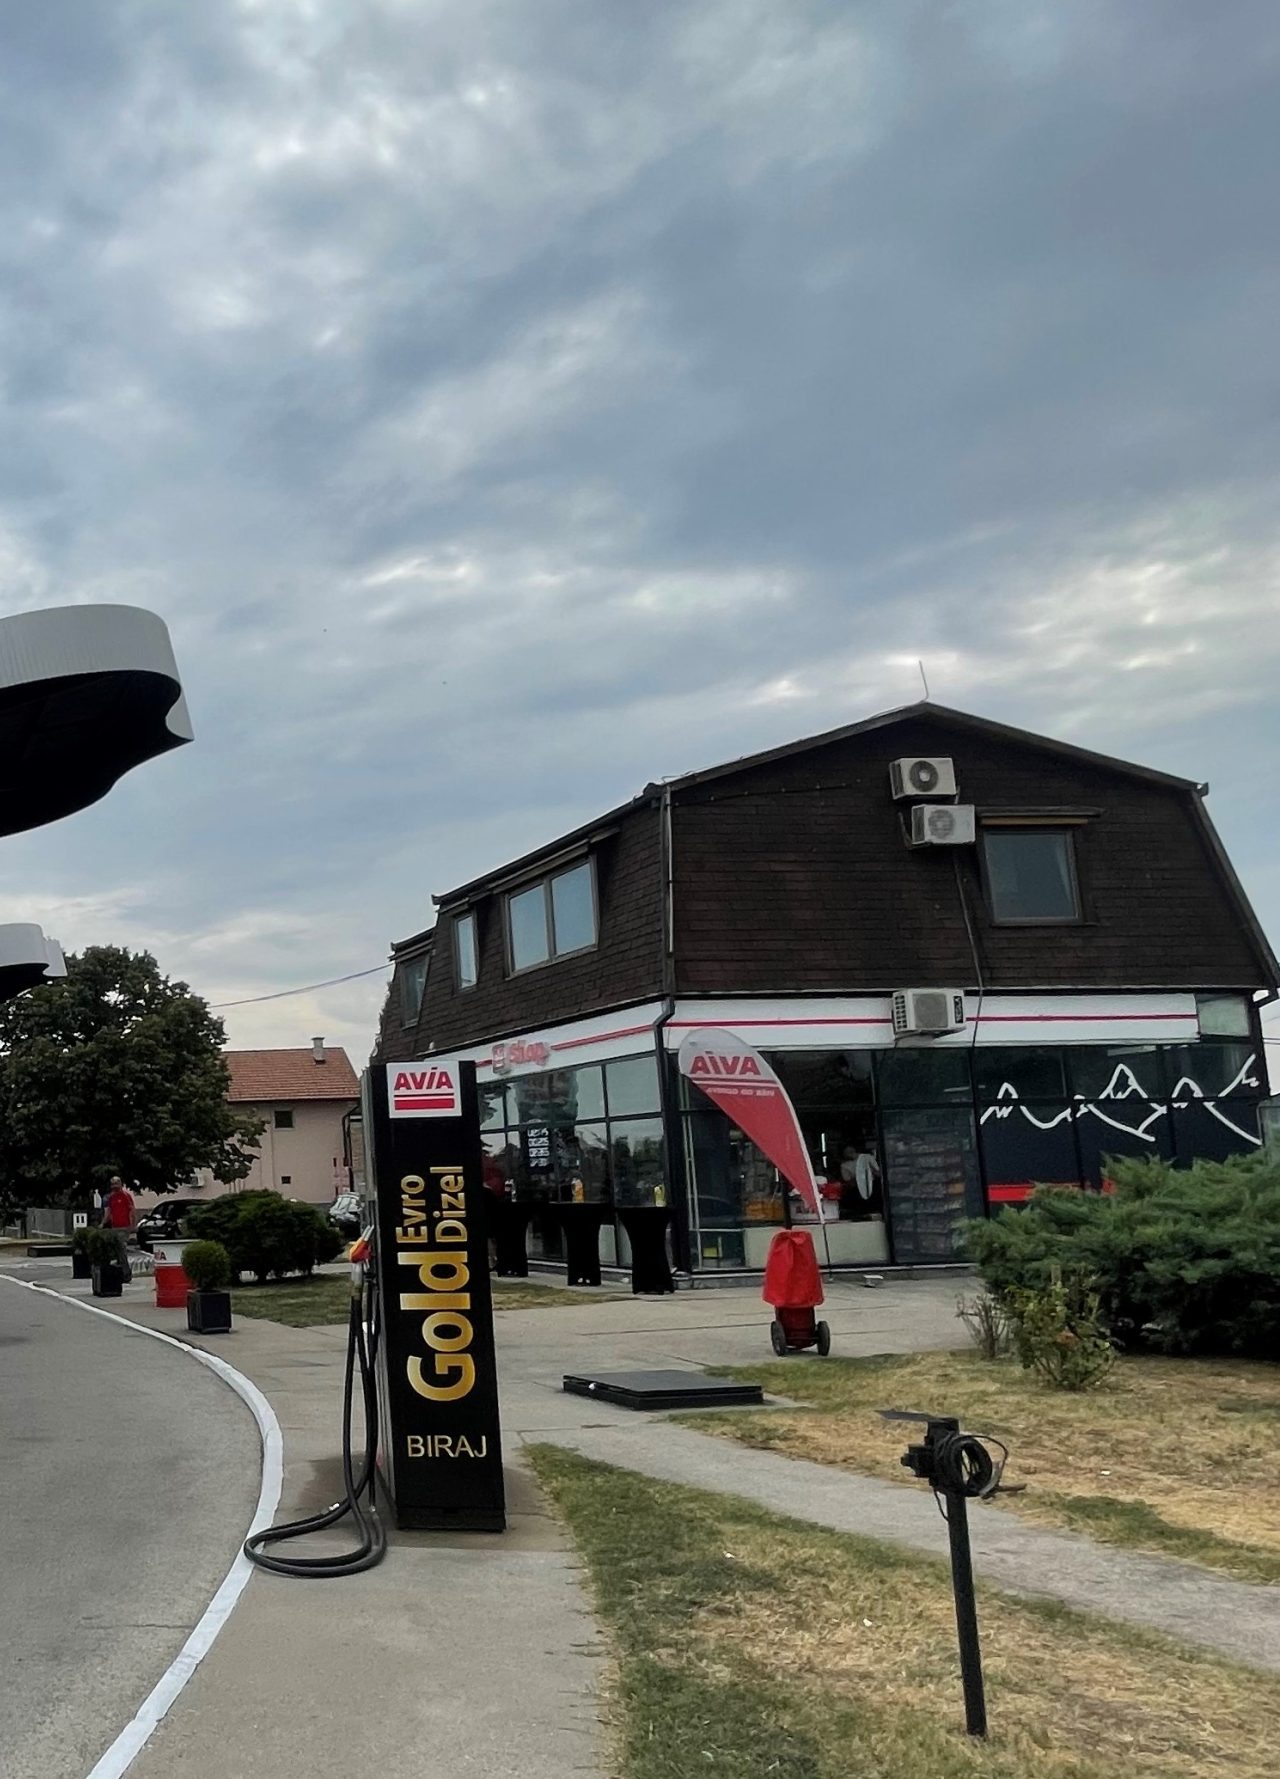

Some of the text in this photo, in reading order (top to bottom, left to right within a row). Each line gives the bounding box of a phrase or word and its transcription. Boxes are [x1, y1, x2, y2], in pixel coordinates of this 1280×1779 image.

[394, 1066, 454, 1090] AVIA
[395, 1174, 428, 1244] Evro
[429, 1166, 467, 1242] Dizel
[397, 1250, 476, 1402] Gold
[407, 1434, 487, 1458] BIRAJ
